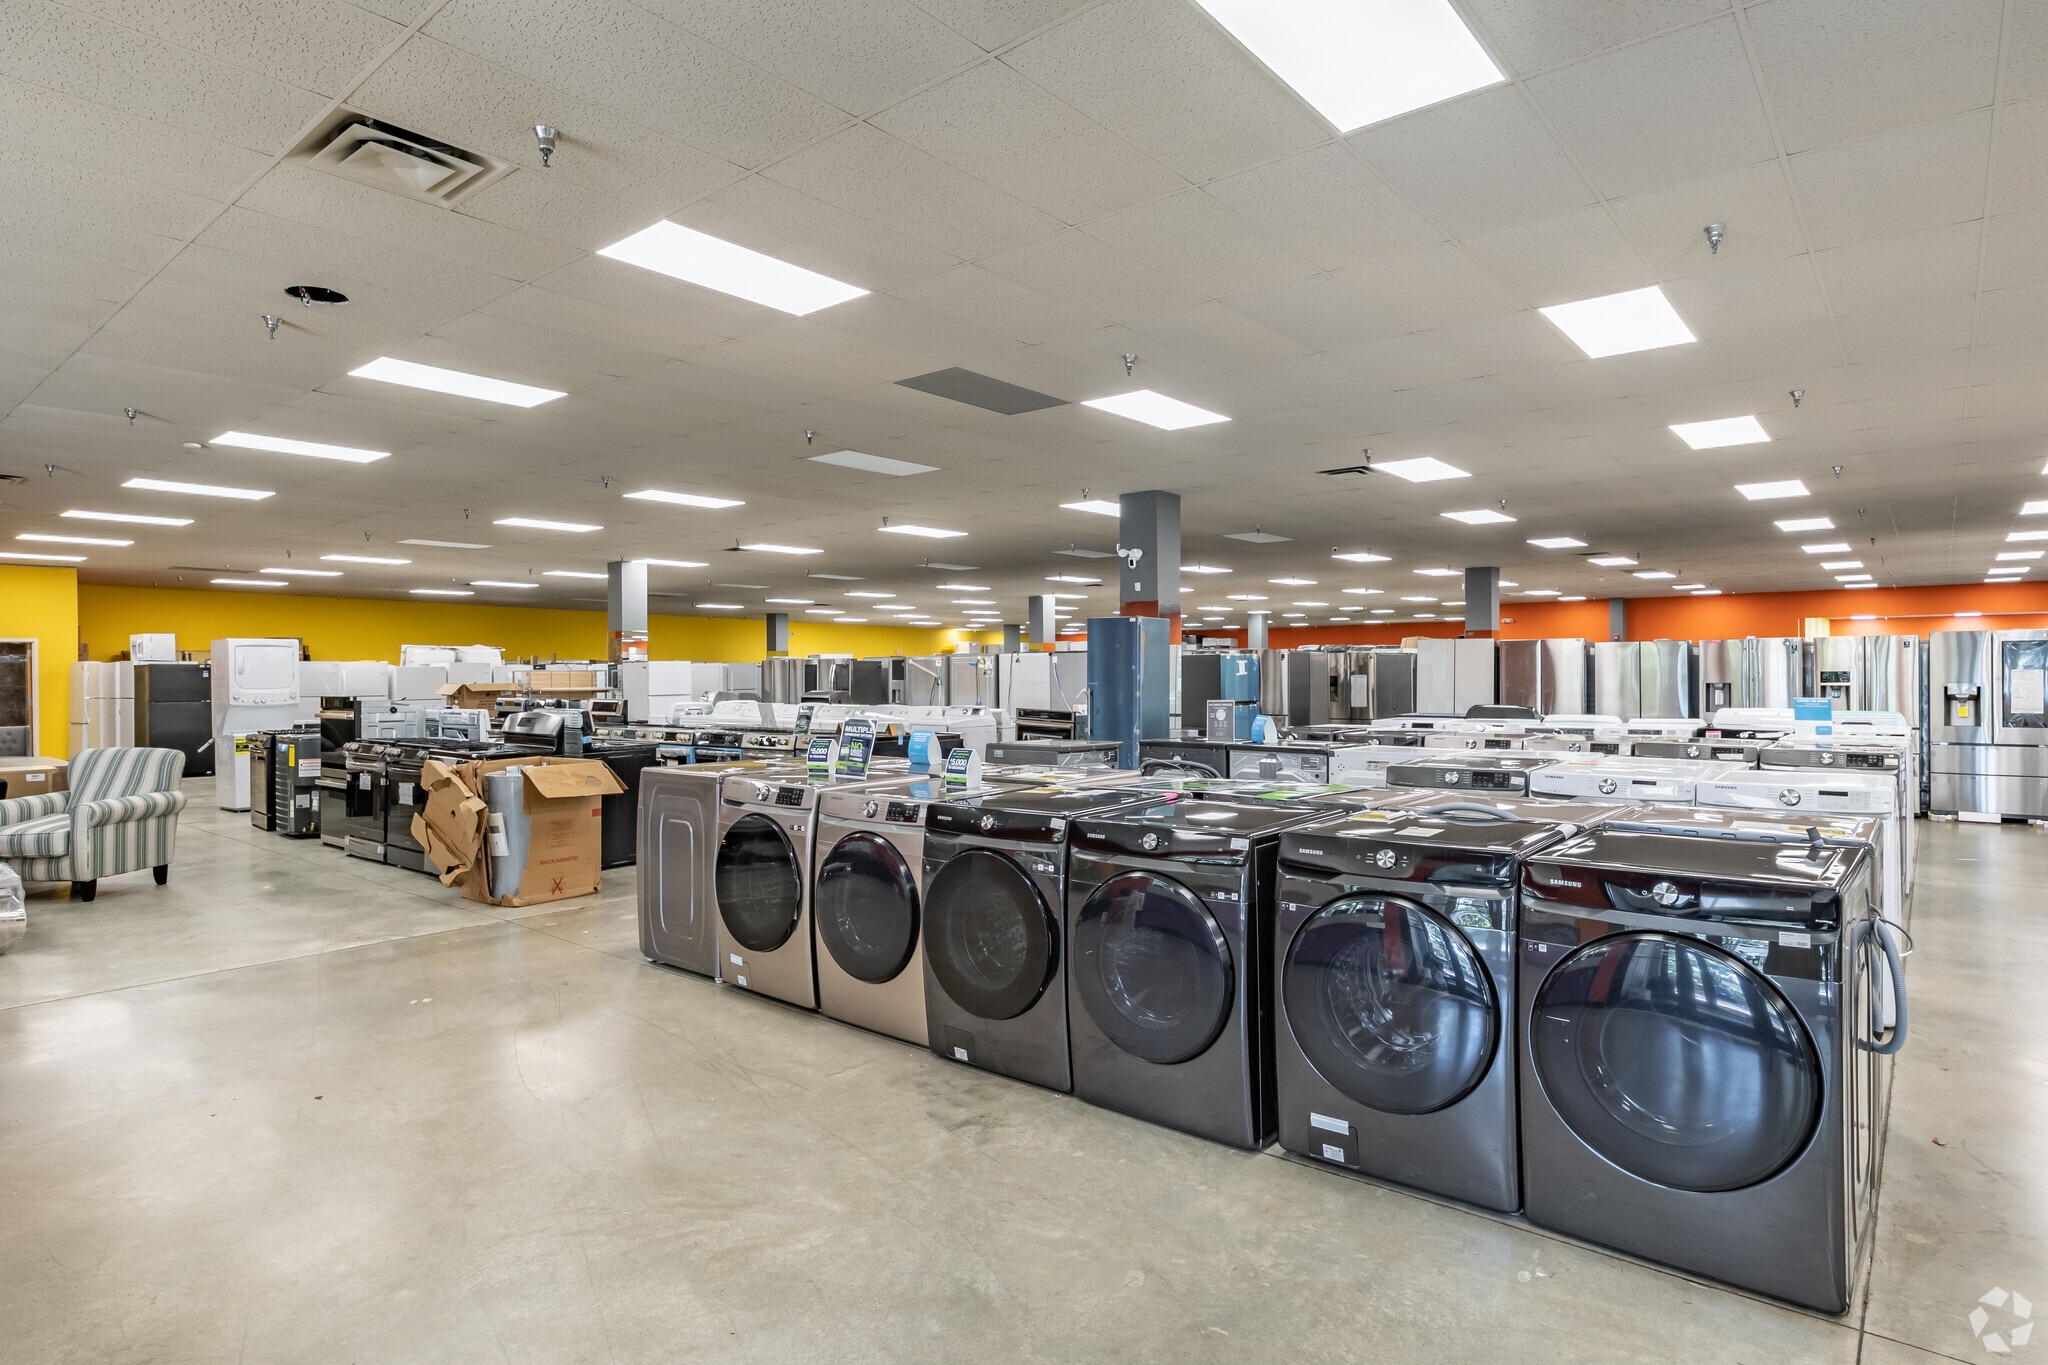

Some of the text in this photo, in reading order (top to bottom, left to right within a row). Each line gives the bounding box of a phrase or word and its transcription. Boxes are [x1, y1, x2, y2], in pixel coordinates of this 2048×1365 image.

[845, 725, 874, 733] MULTIPLE
[850, 741, 863, 751] NO
[1298, 848, 1324, 856] SAMSUNG
[1550, 878, 1582, 888] SAMSUNG
